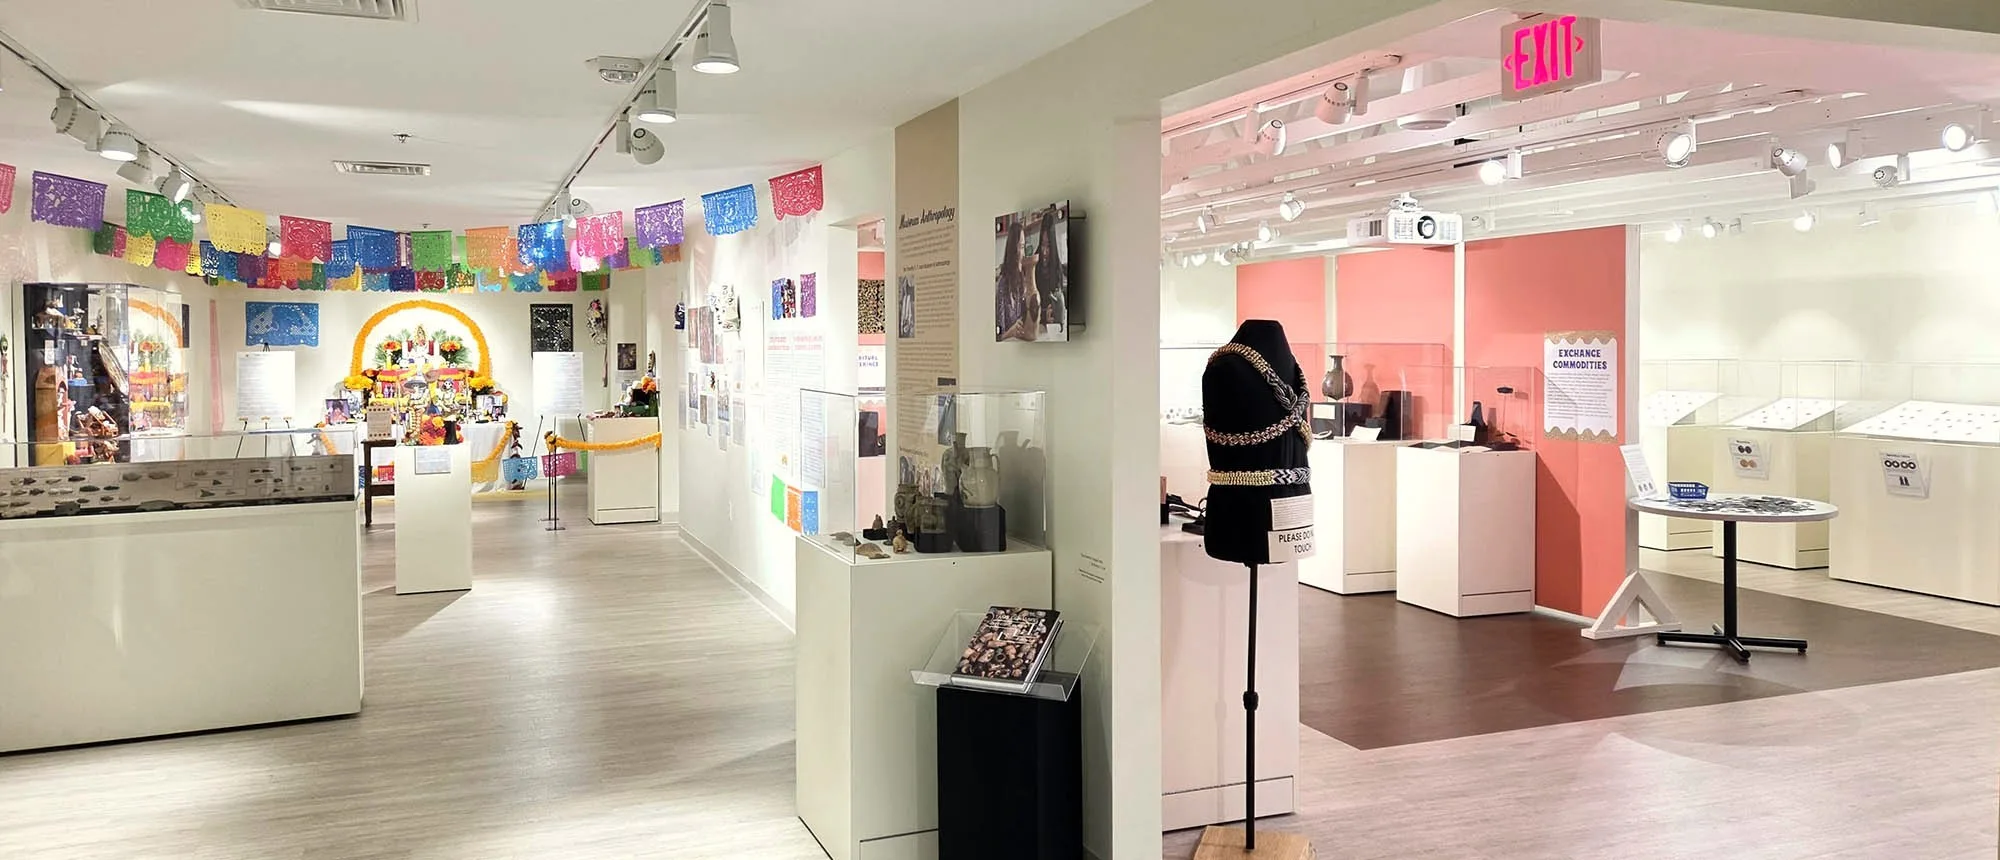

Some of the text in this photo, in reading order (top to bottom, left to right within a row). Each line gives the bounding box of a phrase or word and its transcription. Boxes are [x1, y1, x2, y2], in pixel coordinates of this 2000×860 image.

[1514, 15, 1577, 90] EXIT
[920, 205, 955, 224] Anthropology
[1558, 349, 1601, 358] EXCHANGE
[1552, 360, 1608, 370] COMMODITIES
[1278, 532, 1302, 543] PLEASE
